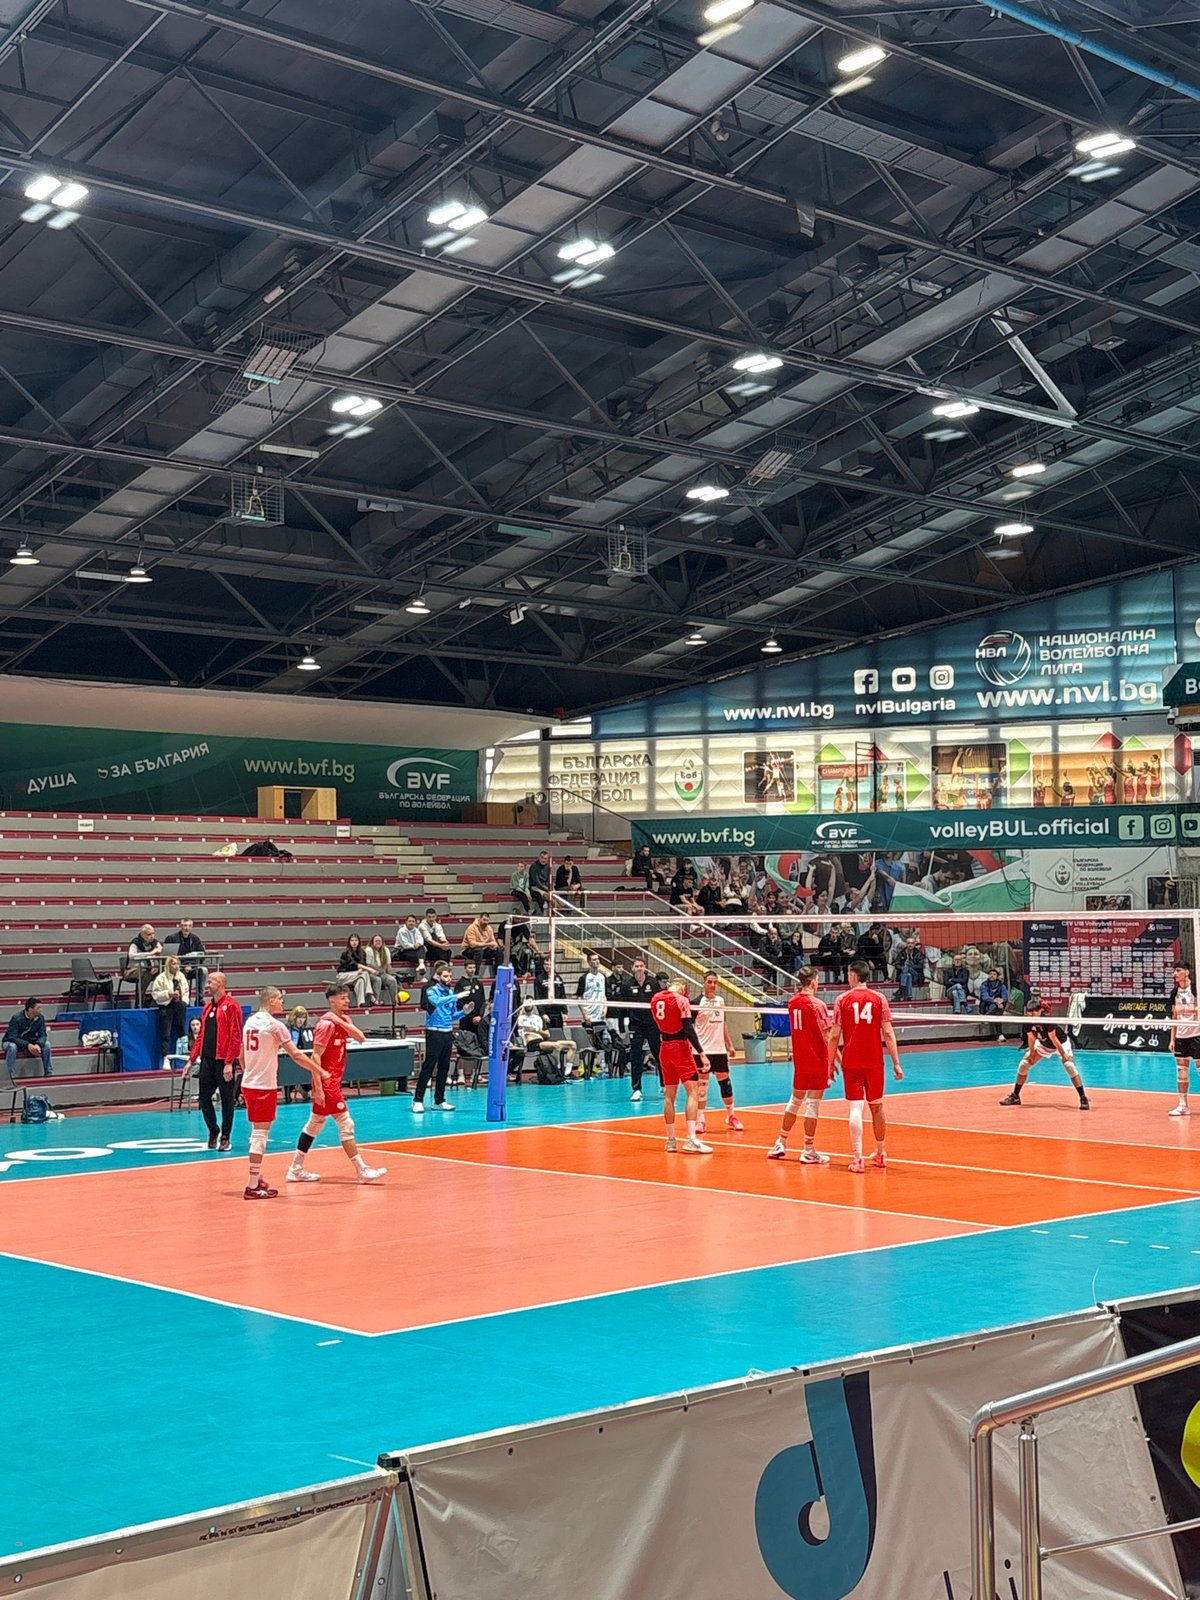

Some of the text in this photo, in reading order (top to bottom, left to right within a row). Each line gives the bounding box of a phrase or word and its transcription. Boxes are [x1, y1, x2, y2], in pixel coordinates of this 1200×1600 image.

[1039, 629, 1156, 647] НАЦИОНАЛНА
[975, 647, 1007, 659] НВЛ
[1039, 643, 1150, 661] ВОЛЕЙБОЛНА
[1041, 662, 1083, 676] ЛИГА
[976, 680, 1157, 708] www.nvl.bg
[723, 702, 834, 721] www.nvl.bg
[855, 698, 956, 715] nvlBulgaria
[110, 742, 210, 778] ЗА БЪЛГАРИЯ
[562, 754, 653, 769] БЪЛГАРСКА
[244, 757, 355, 783] www.bvf.bg
[547, 771, 641, 788] ФЕДЕРАЦИЯ
[27, 772, 78, 794] ДУША
[407, 771, 450, 790] BVF
[550, 787, 632, 804] ВОЛЕЙБОЛ
[652, 828, 755, 847] www.bvf.bg
[829, 828, 858, 838] BVF
[930, 818, 1110, 842] volleyBUL.official
[655, 1000, 665, 1020] 8
[852, 1001, 873, 1024] 14
[1149, 1003, 1167, 1012] PARK
[793, 1008, 803, 1030] 11
[246, 1029, 260, 1051] 15
